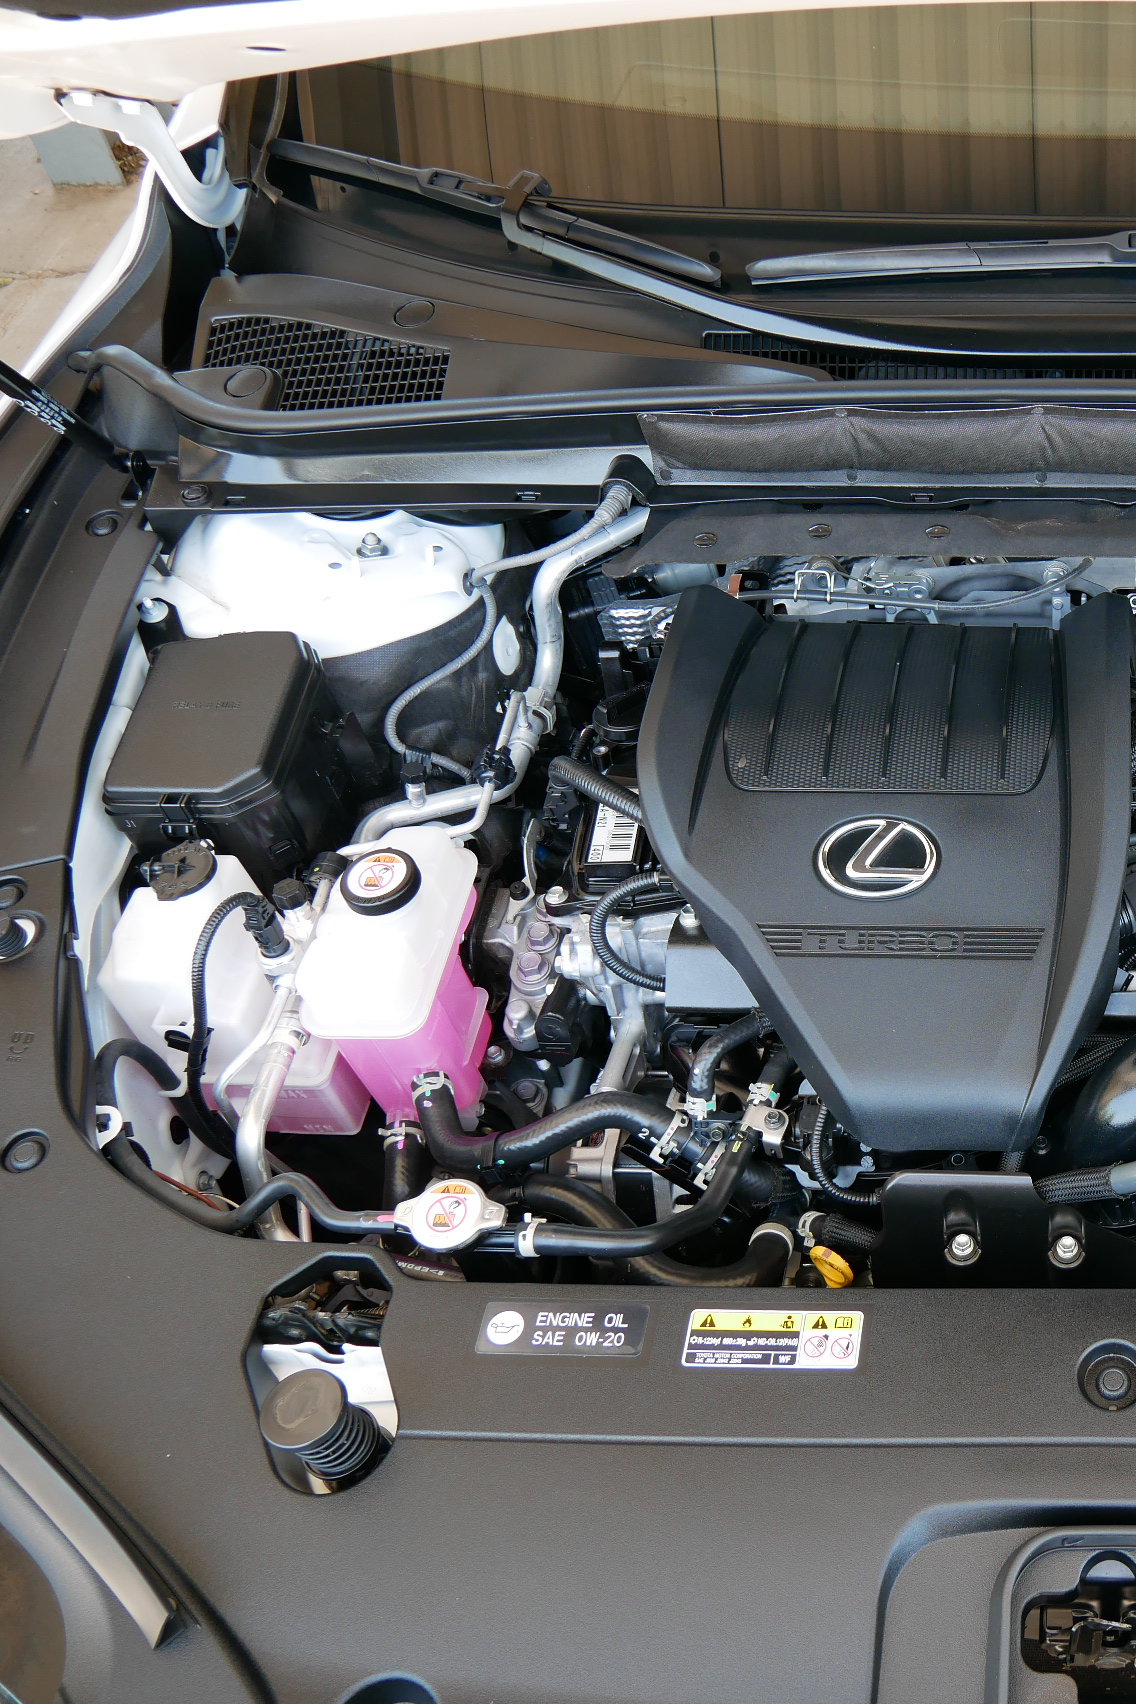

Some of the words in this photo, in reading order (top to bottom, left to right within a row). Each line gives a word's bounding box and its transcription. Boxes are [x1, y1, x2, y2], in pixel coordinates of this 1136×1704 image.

[589, 847, 602, 861] 400
[806, 929, 961, 953] TURBO
[535, 1311, 596, 1328] ENGINE
[603, 1313, 629, 1328] OIL
[531, 1330, 566, 1346] SAE
[574, 1331, 626, 1347] 0W-20
[778, 1355, 792, 1364] WF
